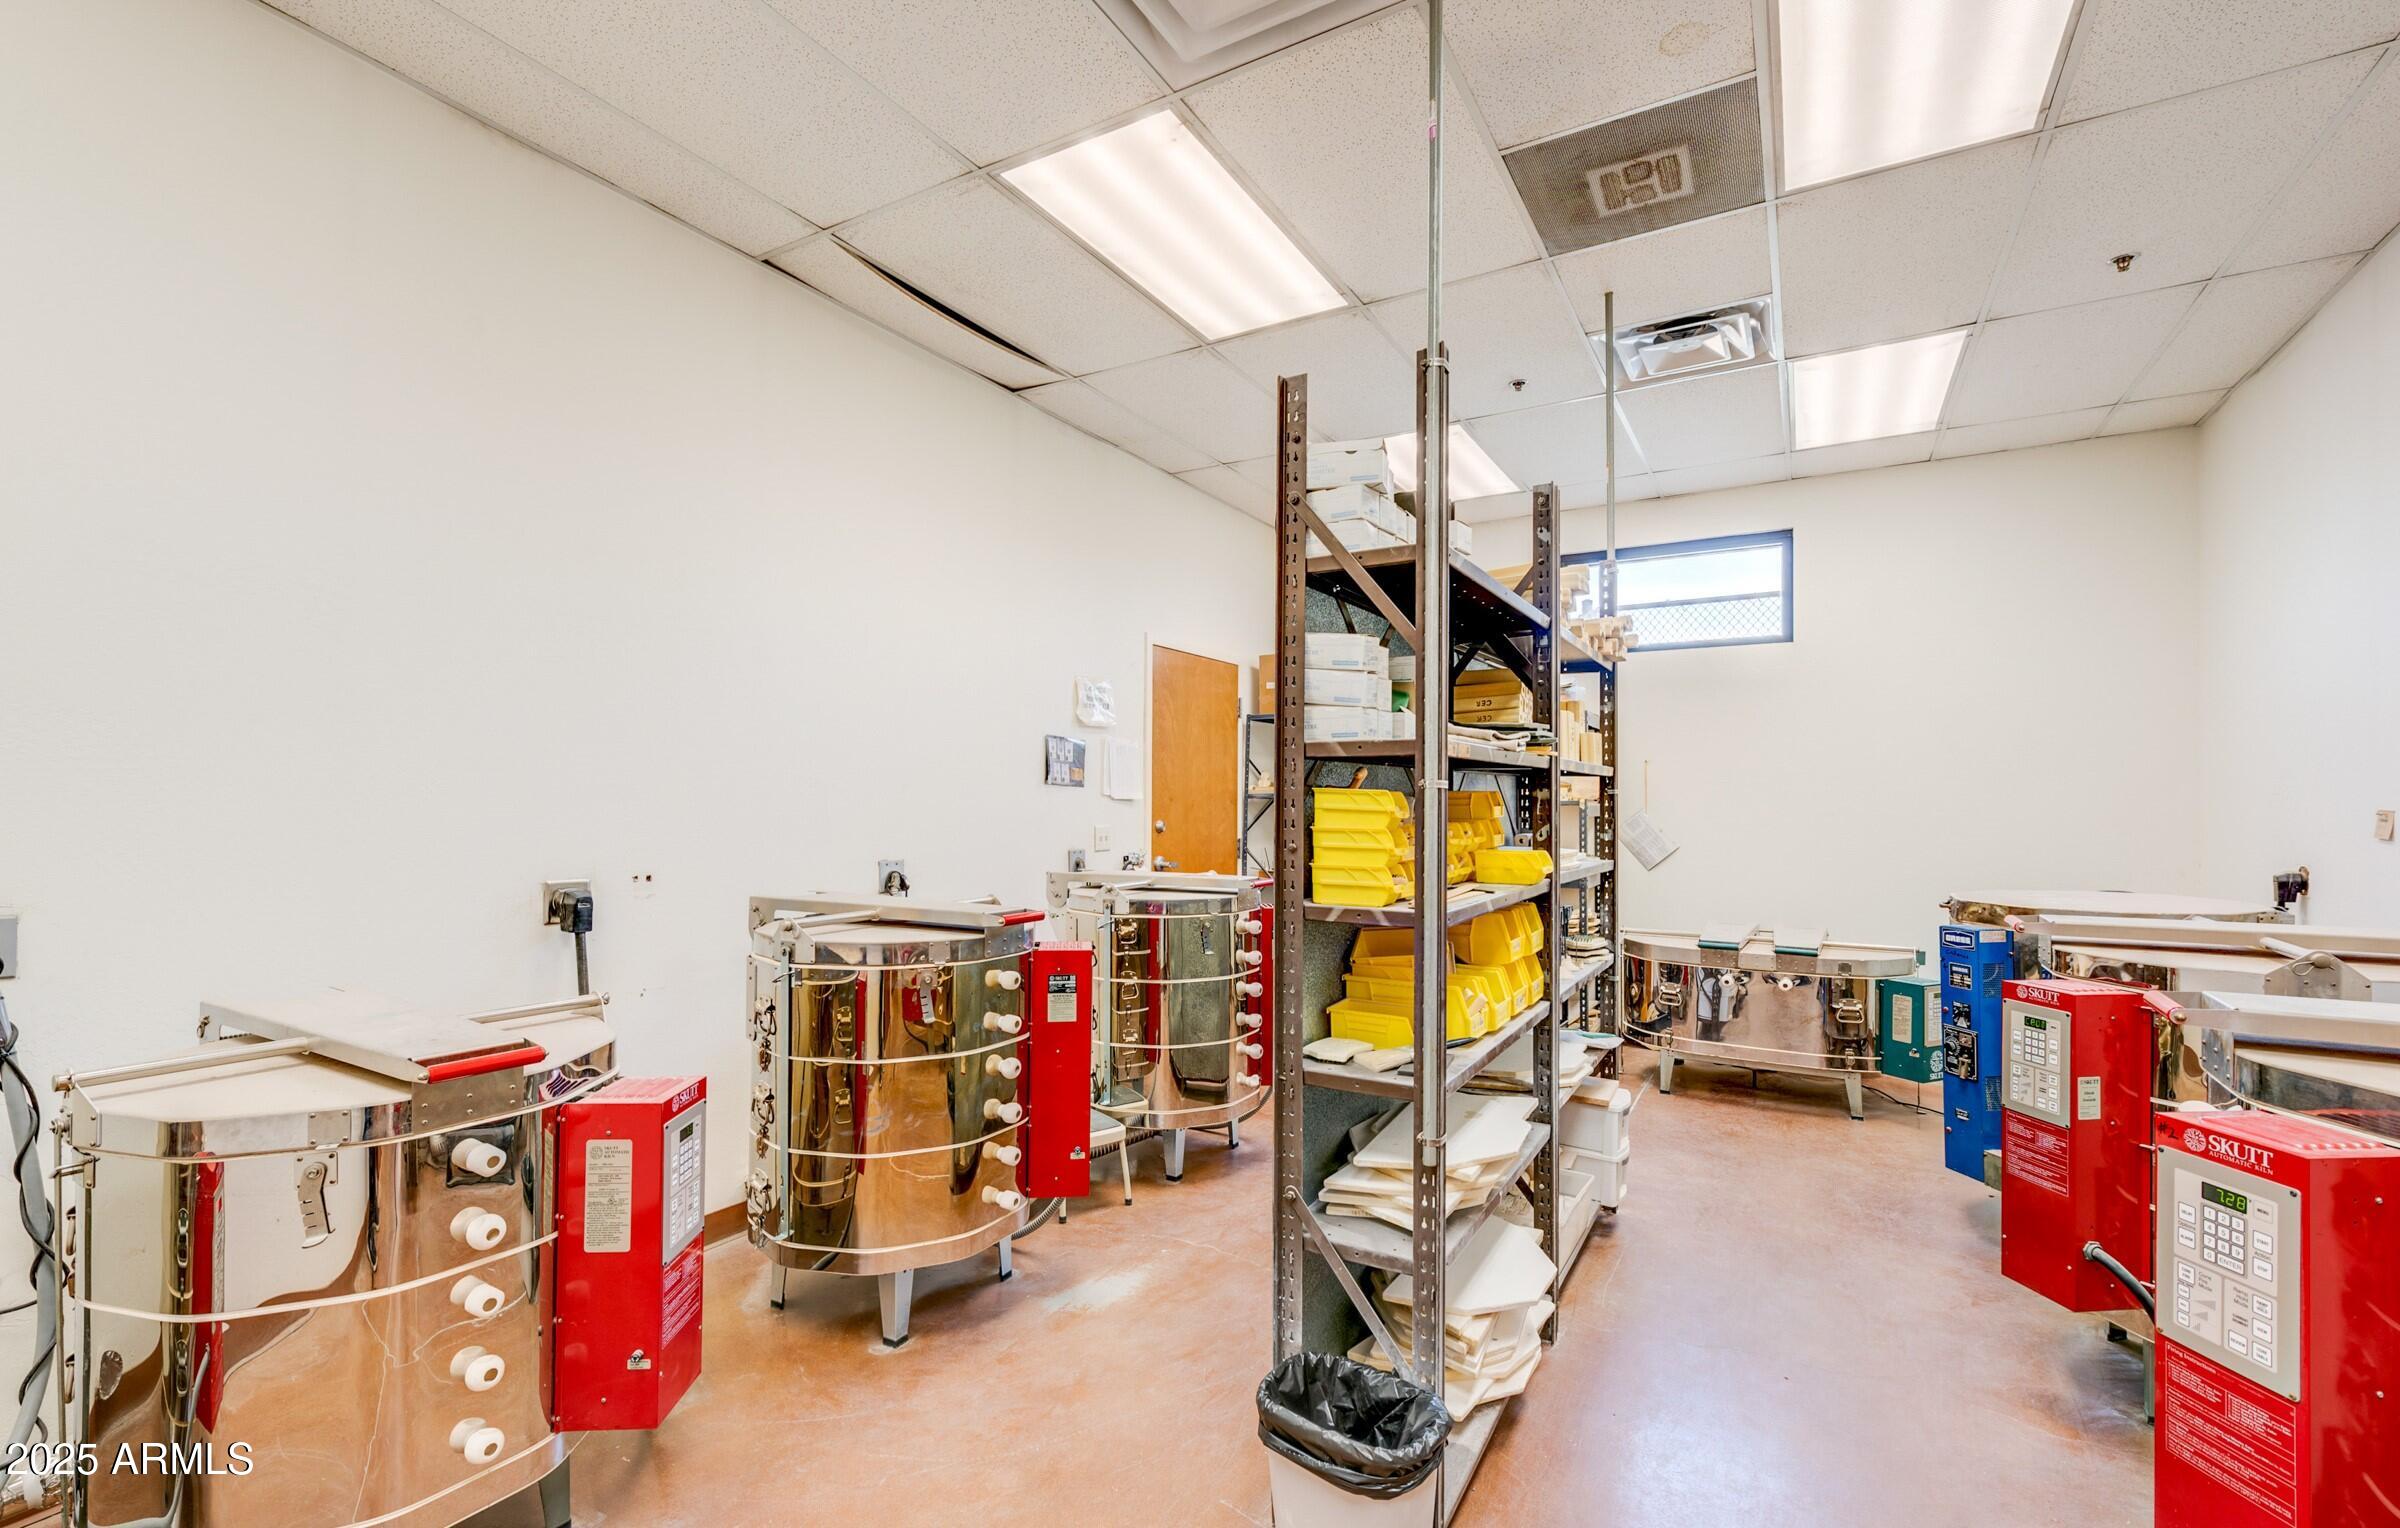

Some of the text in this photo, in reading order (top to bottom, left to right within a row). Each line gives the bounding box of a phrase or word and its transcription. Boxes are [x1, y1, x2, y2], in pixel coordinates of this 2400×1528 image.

[2028, 987, 2060, 1003] SKUTT
[2208, 1134, 2274, 1168] SKUTT
[2208, 1150, 2274, 1176] AUTOMATIC KILN
[2216, 1188, 2246, 1210] 728
[2219, 1257, 2241, 1271] ENTER
